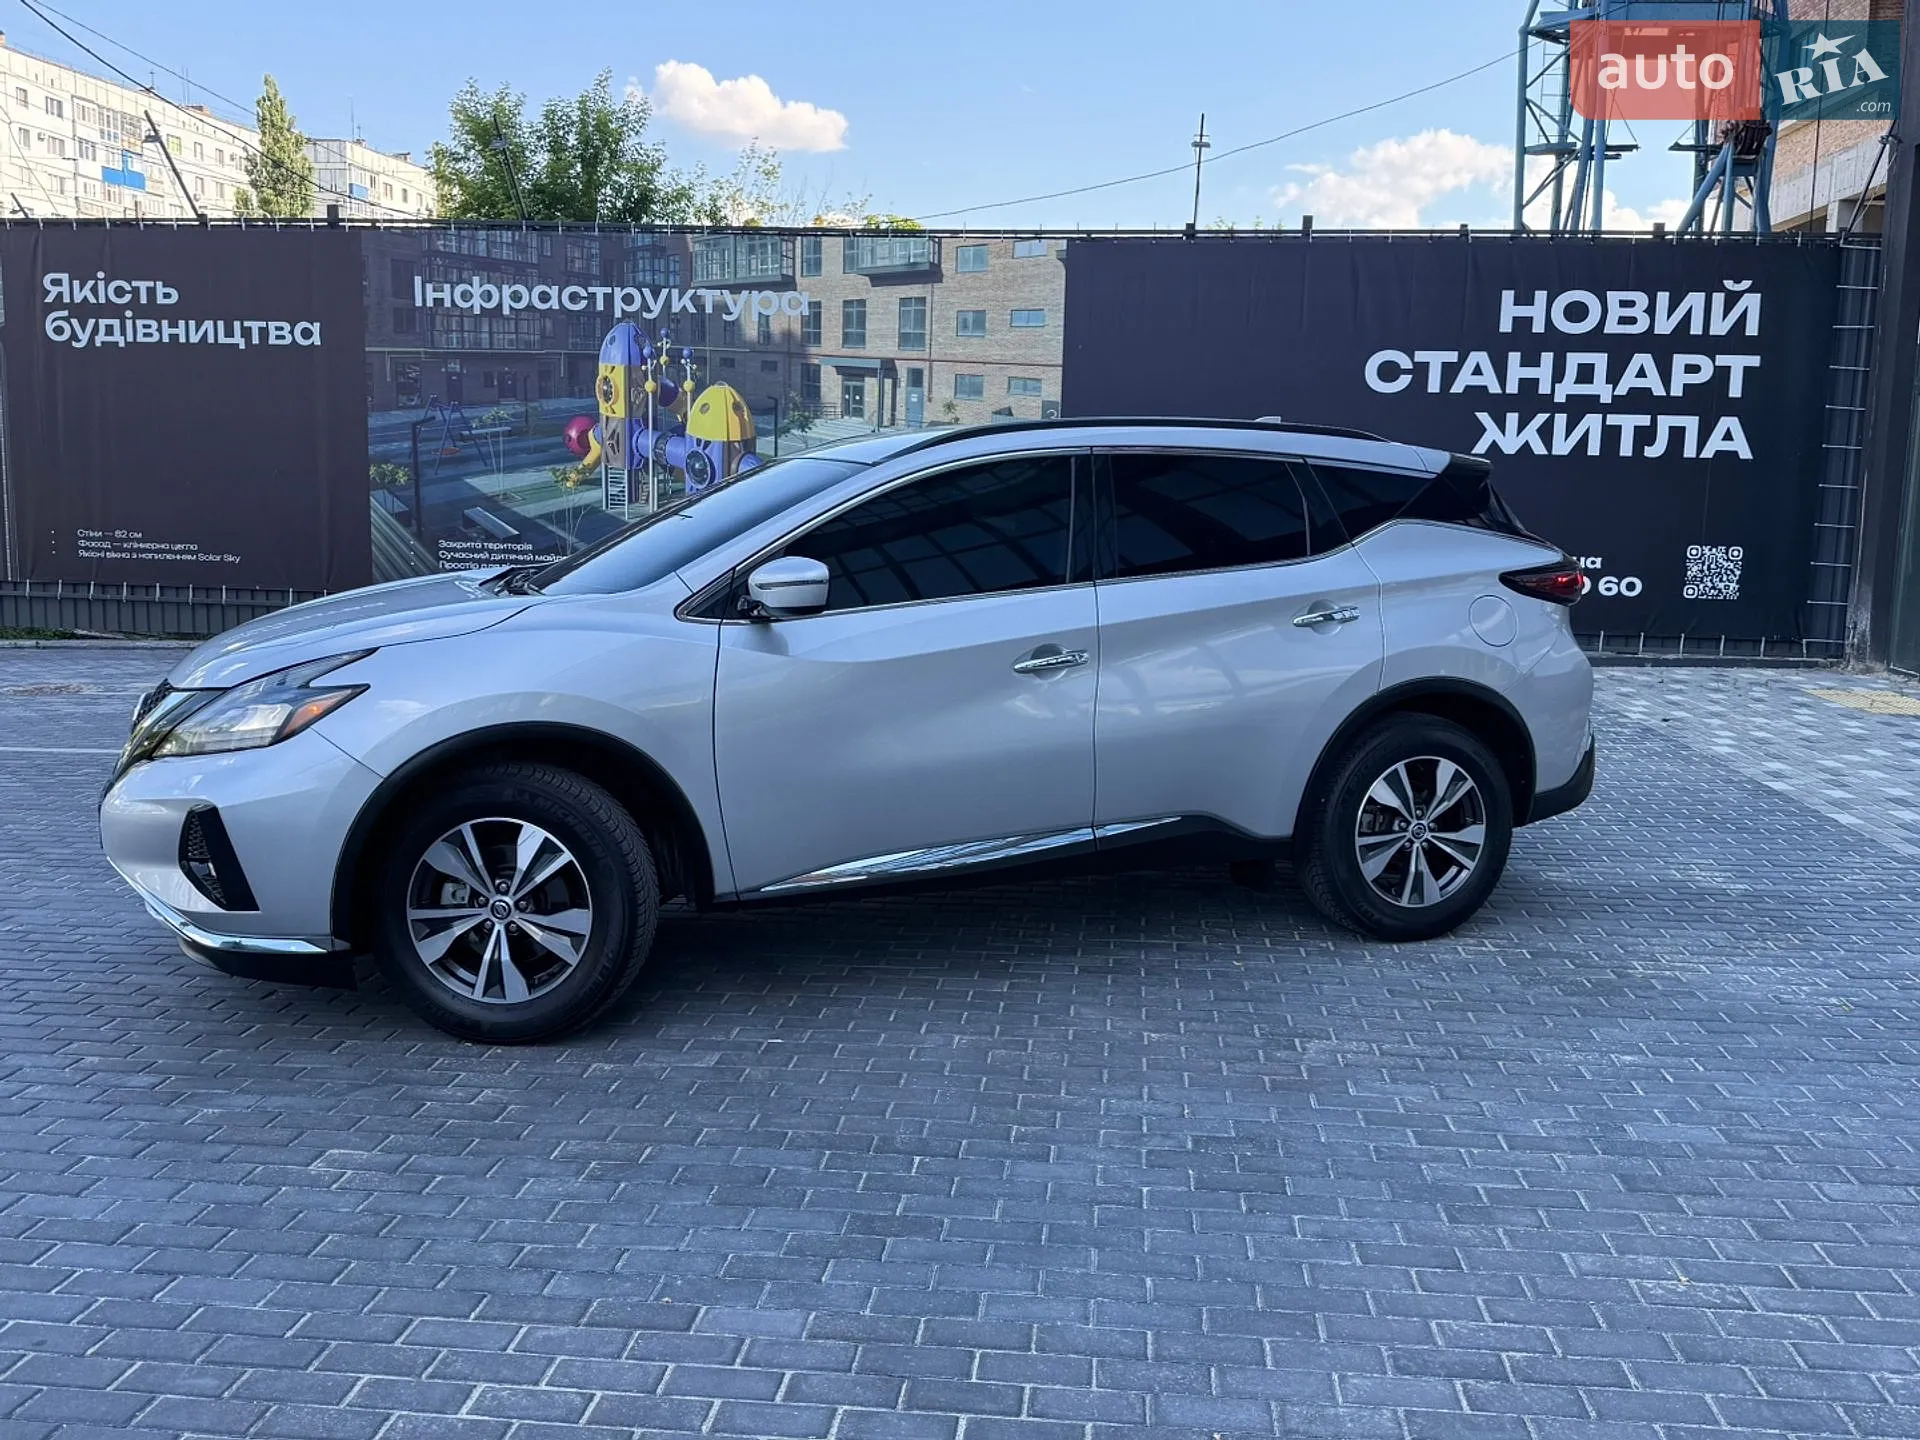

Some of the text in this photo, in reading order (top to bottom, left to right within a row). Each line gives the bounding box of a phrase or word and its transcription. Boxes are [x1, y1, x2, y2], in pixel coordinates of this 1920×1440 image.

[42, 271, 179, 304] Якість
[414, 275, 809, 322] Інфраструктура
[1499, 280, 1762, 336] НОВИЙ
[45, 309, 321, 350] будівництва
[1364, 349, 1761, 404] СТАНДАРТ
[1471, 411, 1753, 460] ЖИТЛА
[77, 529, 103, 538] Стіни
[128, 531, 143, 539] см
[78, 539, 112, 549] Фасад
[123, 541, 170, 551] клінкерна
[171, 543, 198, 552] цегла
[438, 539, 533, 551] Закрита територія
[106, 551, 131, 559] вікна
[197, 552, 221, 562] Solar
[223, 553, 241, 564] Sky
[438, 550, 490, 560] Сучасний
[491, 551, 534, 561] дитячий
[1598, 576, 1643, 597] 60
